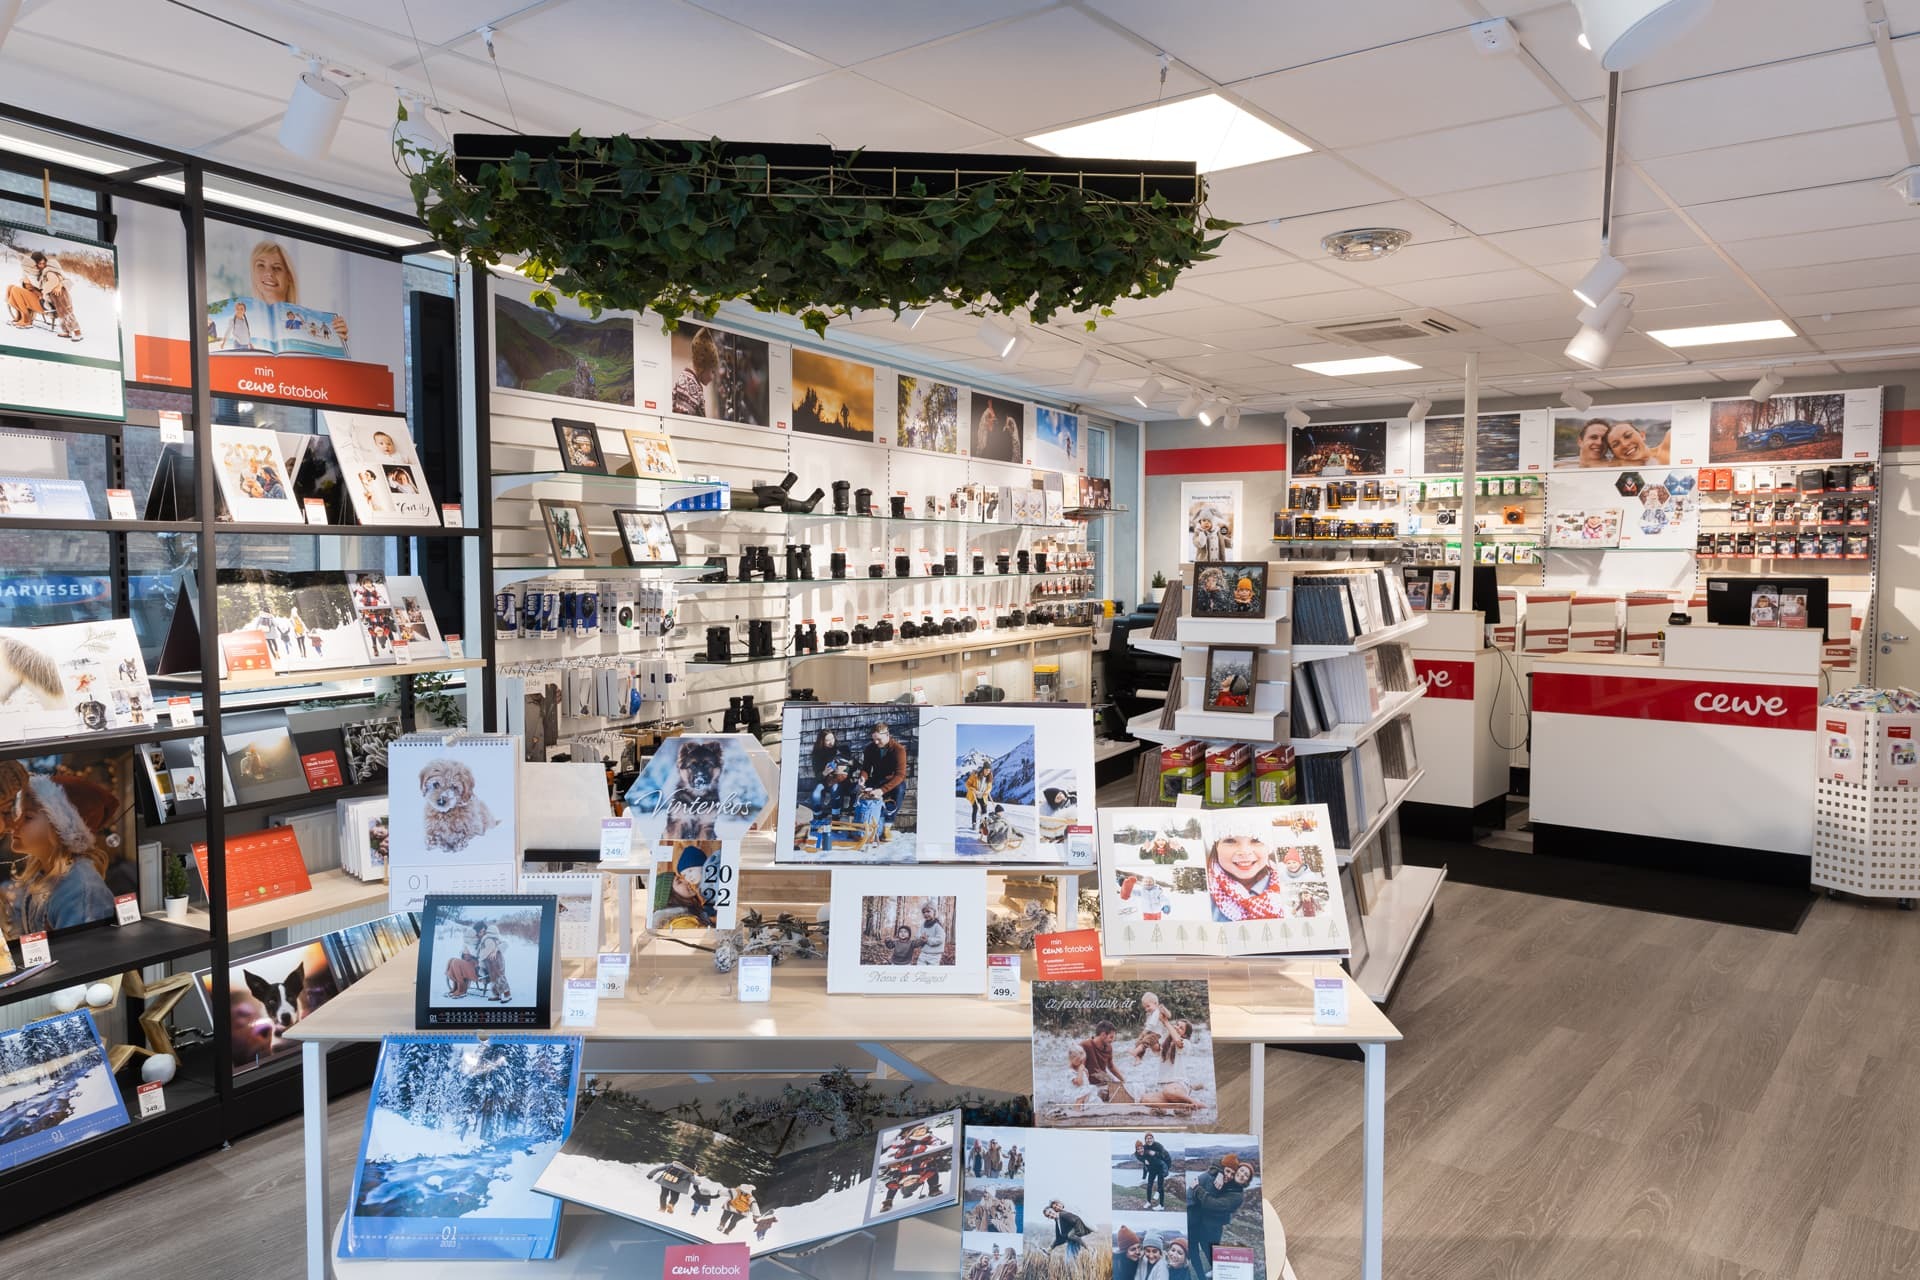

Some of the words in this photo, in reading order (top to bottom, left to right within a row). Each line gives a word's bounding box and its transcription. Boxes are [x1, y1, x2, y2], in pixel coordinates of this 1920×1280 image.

[254, 366, 274, 378] min
[237, 379, 277, 394] cewe
[278, 384, 329, 401] fotobok
[0, 584, 93, 597] ARVESEN
[1694, 692, 1788, 716] cewe
[633, 788, 753, 818] Vinterkos
[703, 864, 732, 884] 20
[408, 874, 430, 890] 01
[702, 888, 731, 907] 22
[1050, 938, 1062, 946] min
[1064, 944, 1095, 953] fotobok
[993, 987, 1016, 998] 499,-
[441, 1225, 457, 1240] 01
[684, 1253, 700, 1263] min
[671, 1264, 701, 1275] cewe
[701, 1264, 740, 1275] fotobok
